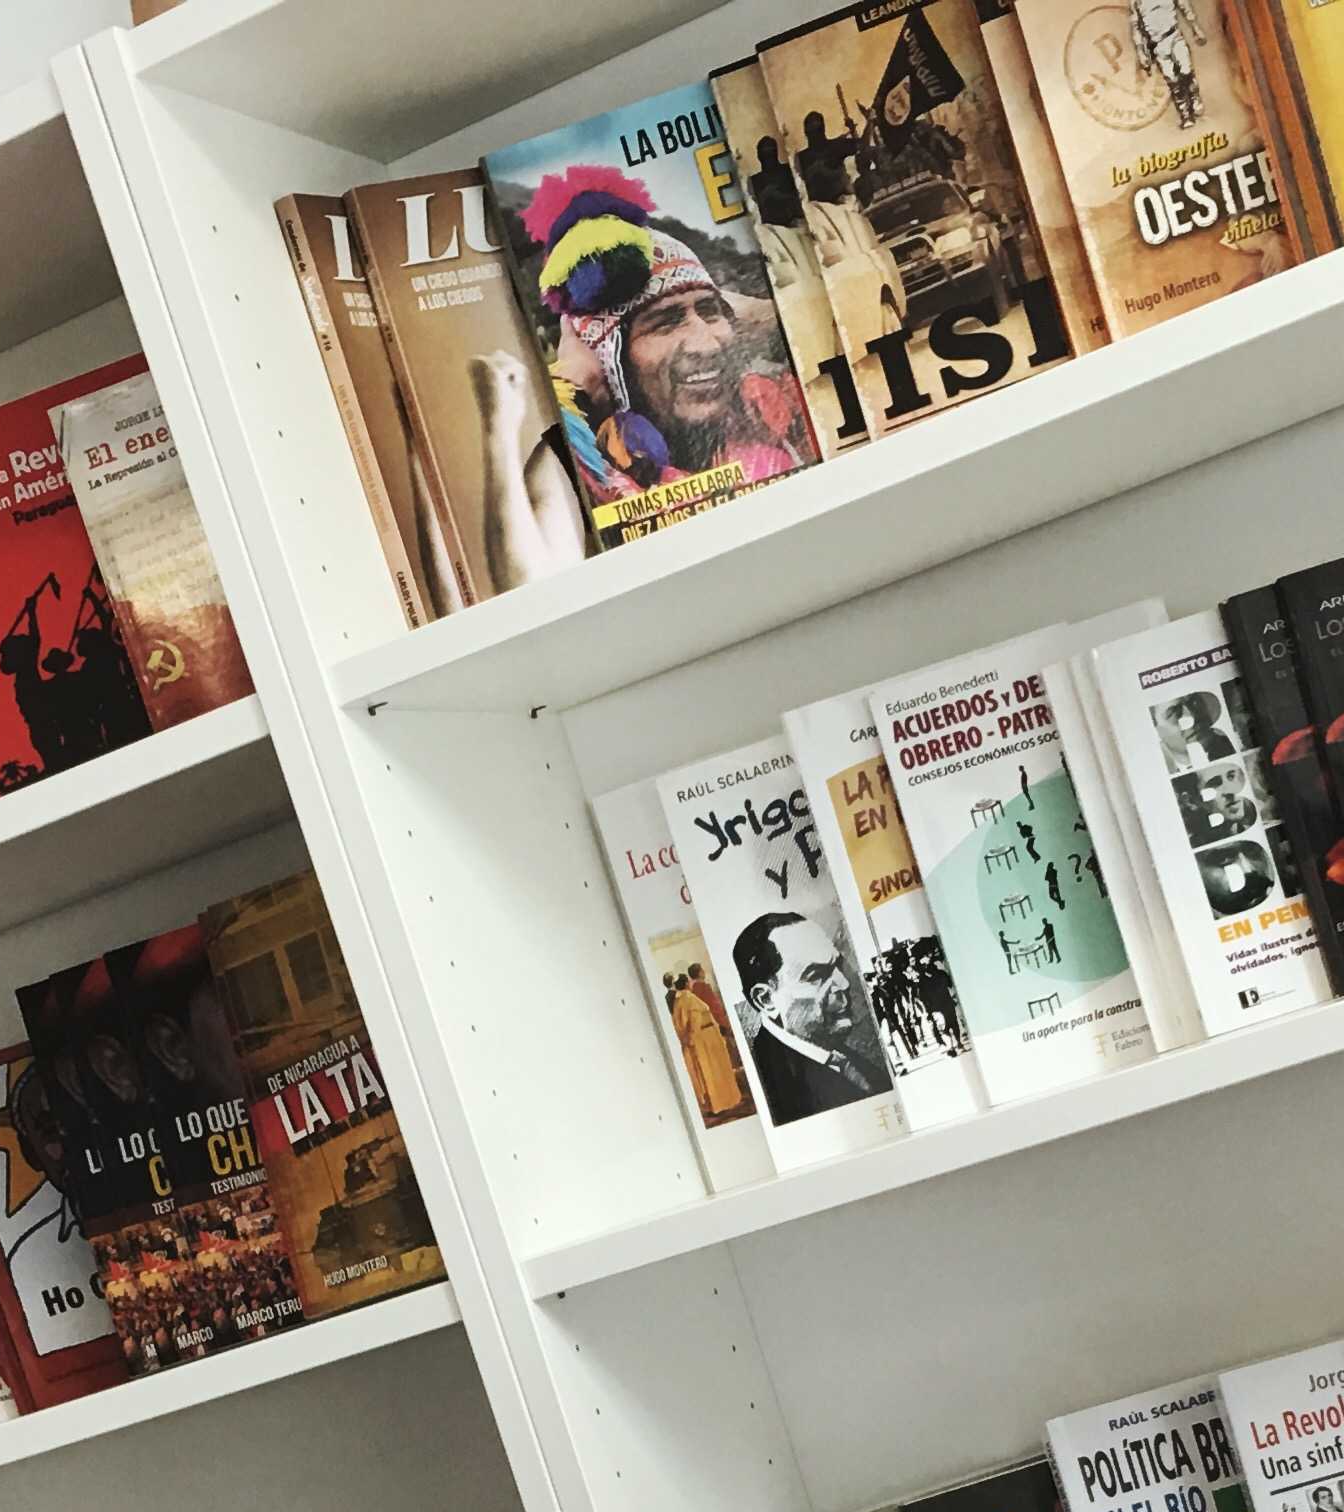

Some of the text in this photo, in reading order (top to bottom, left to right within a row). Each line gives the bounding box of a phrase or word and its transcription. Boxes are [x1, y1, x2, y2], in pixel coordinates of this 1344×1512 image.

[620, 128, 656, 167] LA
[1112, 133, 1229, 187] la biografía
[1125, 269, 1221, 314] Hugo Montero
[84, 442, 118, 470] El
[88, 479, 102, 490] La
[613, 490, 662, 523] TOMÁS
[664, 464, 745, 505] ASTELARRA
[1141, 656, 1209, 688] ROBERTO
[885, 669, 999, 716] Eduardo Benedetti
[892, 689, 999, 743] ACUERDOS
[899, 726, 983, 770] OBRERO
[908, 737, 1036, 786] CONSEJOS ECONÓMICOS
[677, 782, 715, 803] RAÚL
[842, 769, 873, 806] LA
[853, 803, 888, 838] EN
[626, 848, 656, 880] La
[1217, 920, 1253, 943] EN
[1226, 935, 1304, 963] Vidas ilustres
[1230, 952, 1288, 975] olvidados,
[1022, 1007, 1105, 1043] Un aporte la
[267, 1034, 361, 1094] DE NICARAGUA A
[273, 1051, 386, 1145] LA TA
[175, 1097, 249, 1142] LO QUE
[117, 1132, 145, 1163] LO
[347, 1255, 388, 1282] MONTERO
[41, 1283, 84, 1317] Ho
[236, 1305, 274, 1331] MARCO
[177, 1326, 214, 1350] MARCO
[1250, 1421, 1280, 1450] La
[1077, 1428, 1196, 1503] POLÍTICA
[1260, 1452, 1303, 1480] Una
